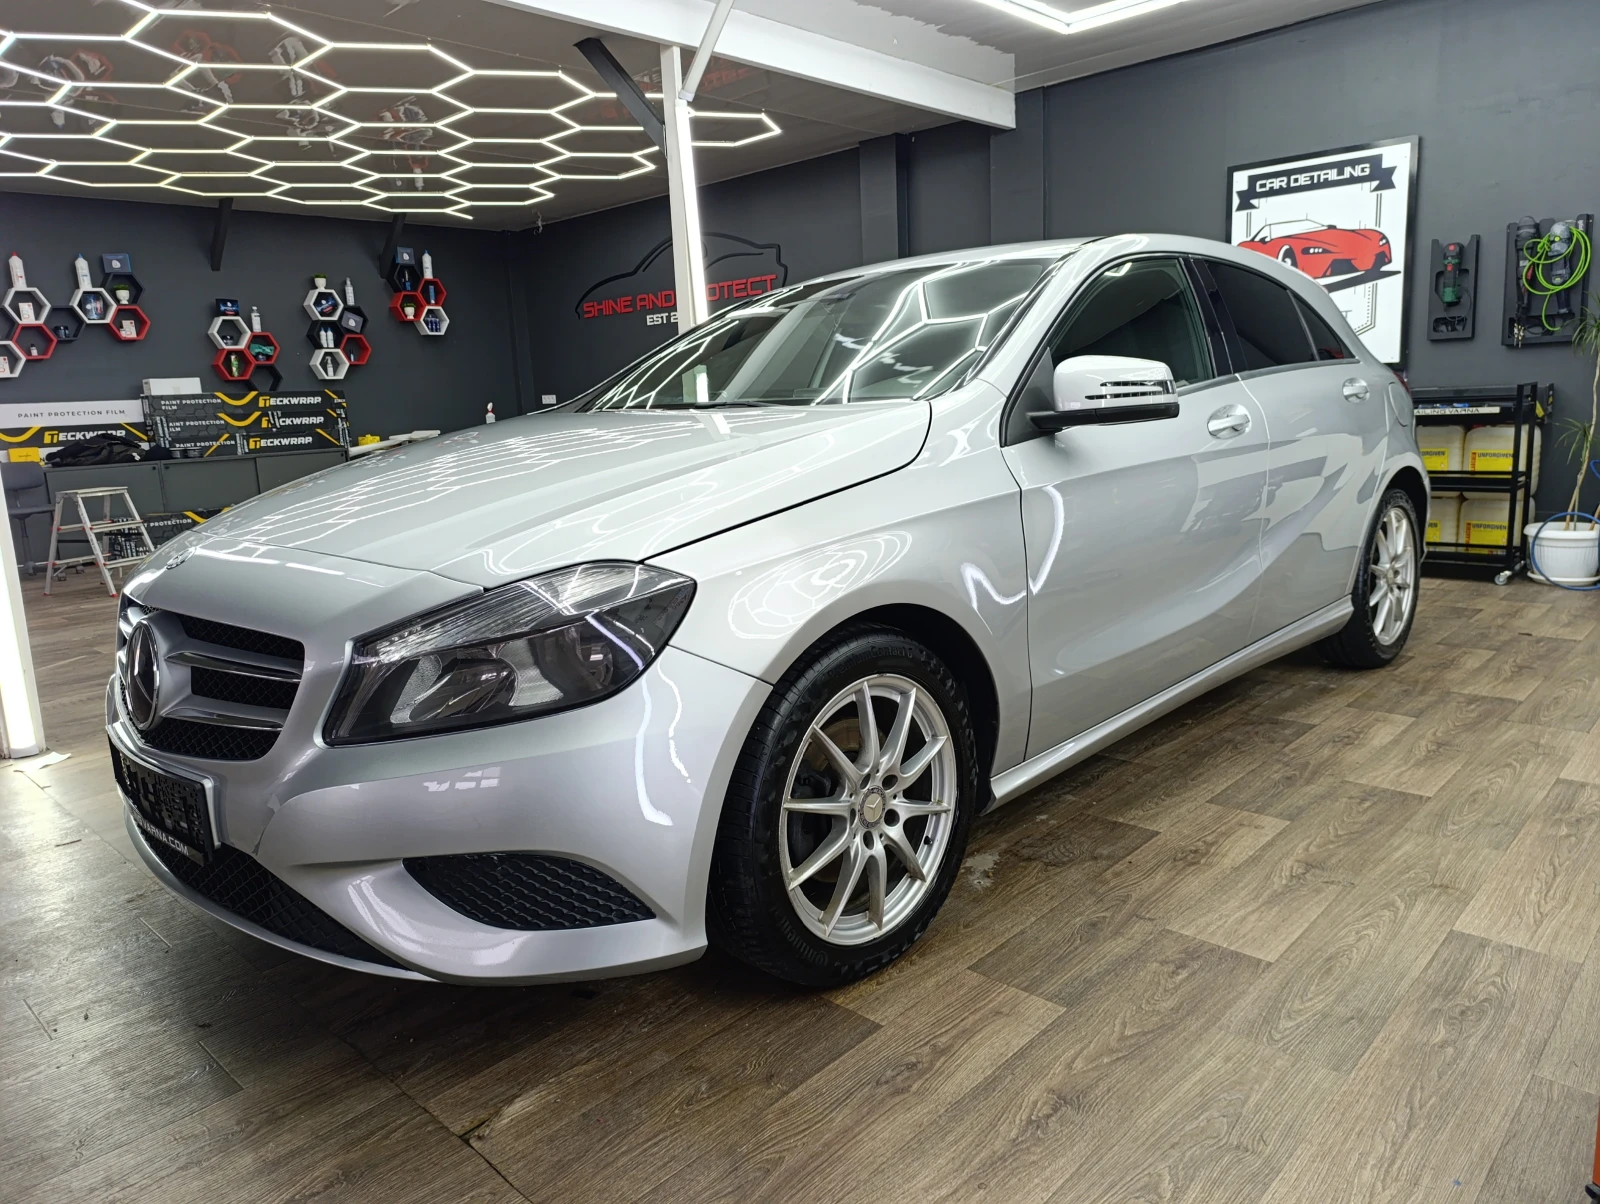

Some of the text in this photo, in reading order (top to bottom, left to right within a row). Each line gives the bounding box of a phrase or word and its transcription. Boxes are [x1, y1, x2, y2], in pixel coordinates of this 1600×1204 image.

[1256, 163, 1370, 192] CAR DETAILING
[583, 296, 633, 318] SHINE
[636, 290, 676, 311] AND
[646, 313, 668, 325] EST
[258, 396, 322, 407] TECKWRAP
[261, 416, 324, 428] TCKWRAP
[249, 436, 313, 449] TECKWRAP
[149, 519, 192, 527] PROTECTION
